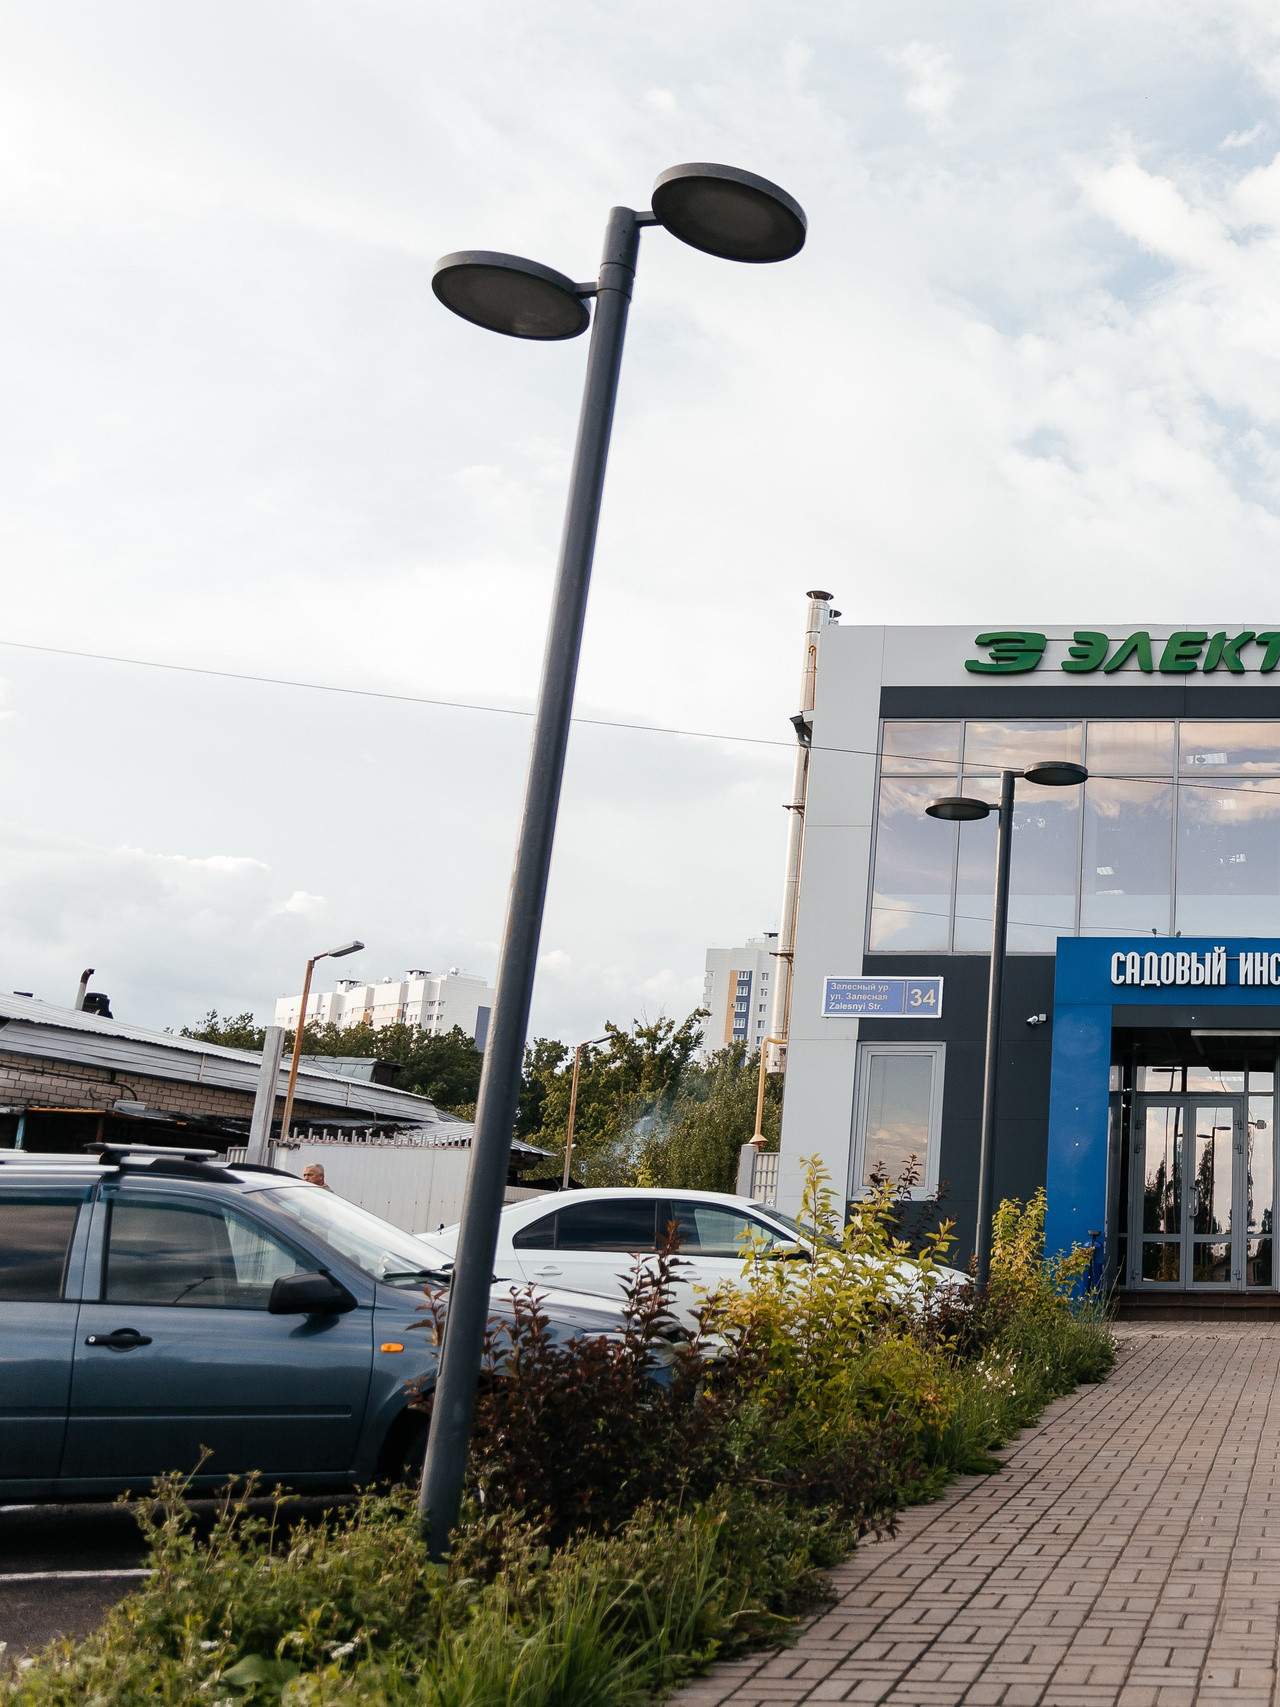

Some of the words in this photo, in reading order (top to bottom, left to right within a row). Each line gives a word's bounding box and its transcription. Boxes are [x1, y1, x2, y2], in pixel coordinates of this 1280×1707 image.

[1110, 946, 1226, 986] САДОВЫЙ
[831, 982, 875, 990] Залесный
[829, 993, 843, 1001] ул.
[845, 992, 888, 1000] Залесная
[909, 988, 936, 1007] 34
[828, 1002, 866, 1011] Zalesnyi
[867, 1002, 883, 1010] Str.
